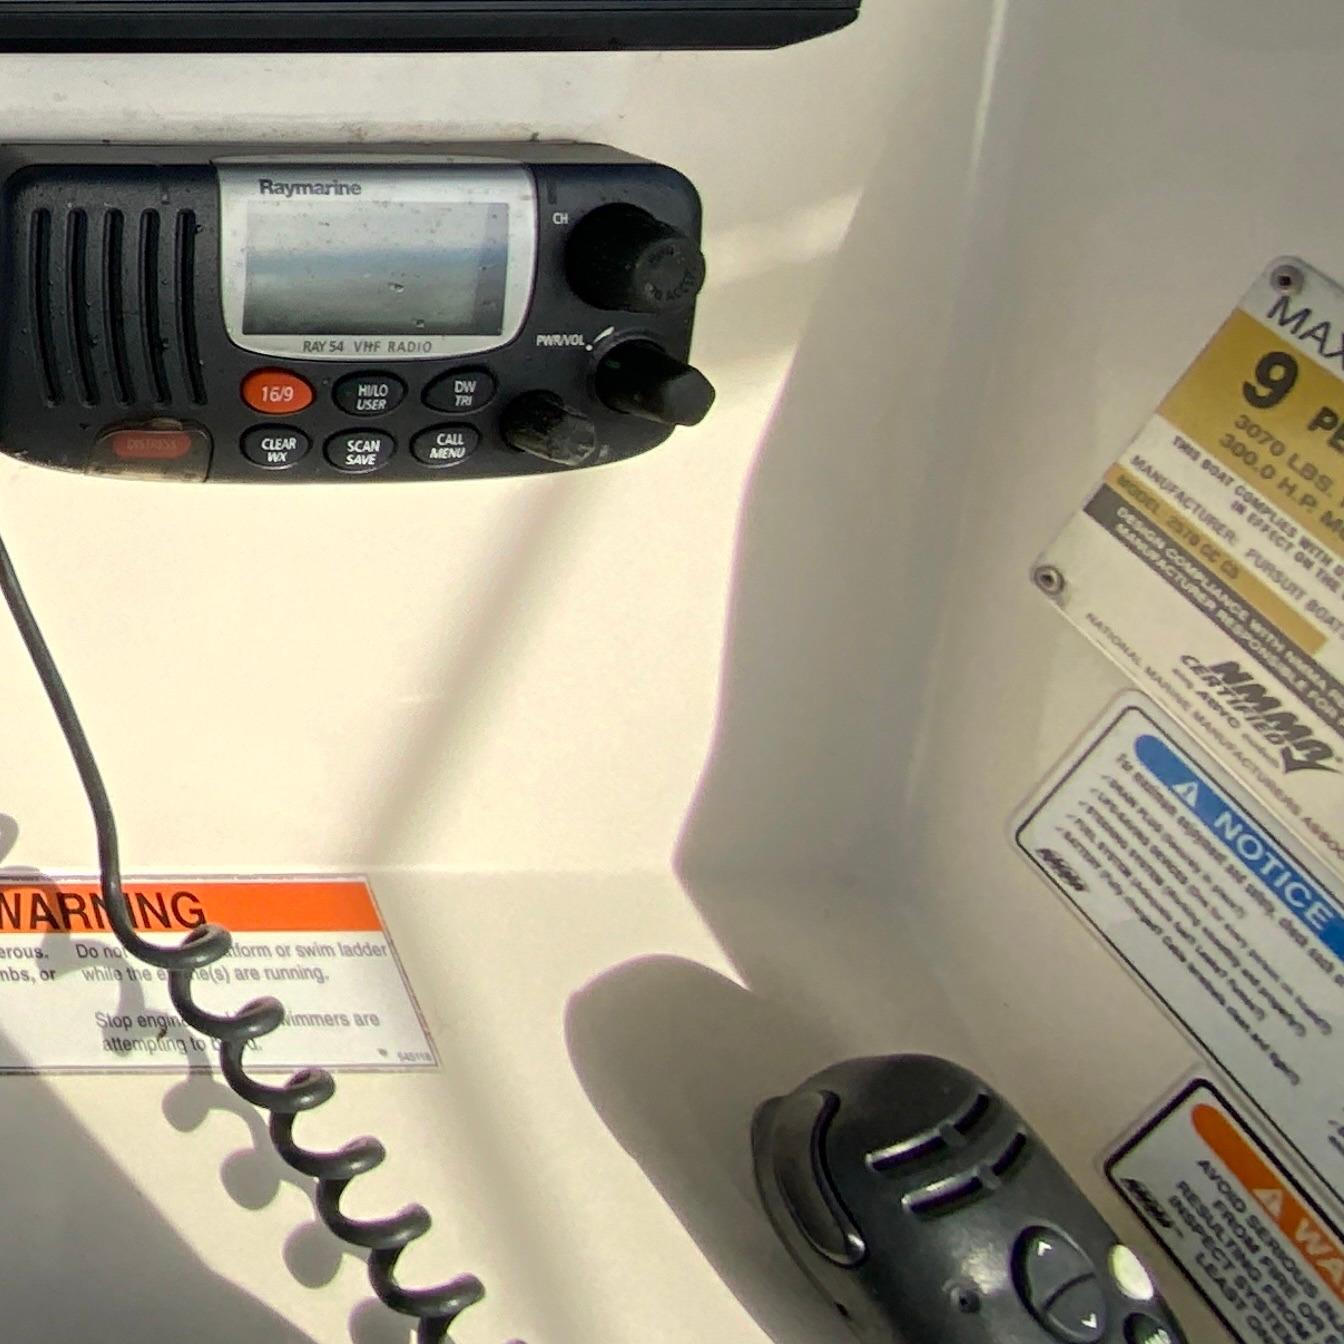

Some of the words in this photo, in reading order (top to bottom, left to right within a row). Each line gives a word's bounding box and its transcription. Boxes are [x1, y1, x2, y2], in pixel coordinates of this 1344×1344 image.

[259, 178, 362, 198] Raymarine
[552, 212, 569, 225] CH
[303, 340, 325, 353] RAY
[329, 340, 345, 353] 54
[354, 340, 381, 353] VHF
[388, 340, 433, 353] RADIO
[536, 334, 585, 347] PWR/VOL
[454, 379, 477, 394] DW
[1242, 351, 1299, 409] 9
[261, 385, 294, 403] 16/9
[455, 394, 473, 407] TRI
[356, 398, 387, 411] USER
[261, 437, 297, 451] CLEAR
[436, 432, 464, 446] CALL
[1234, 414, 1286, 457] 3070
[346, 439, 381, 453] SCAN
[429, 446, 467, 460] MENU
[267, 451, 287, 463] WX
[346, 453, 377, 466] SAVE
[1219, 432, 1277, 480] 300.0
[1199, 457, 1234, 488] BOAT
[1232, 483, 1299, 539] COMPLIES
[1244, 511, 1294, 554] EFFECT
[1162, 545, 1249, 621] COMPLIANCE
[1245, 548, 1307, 600] PURSUIT
[1177, 650, 1287, 749] CERTIFIED
[1214, 810, 1335, 931] NOTICE
[76, 943, 98, 959] Do
[276, 944, 291, 958] or
[296, 942, 336, 957] swim
[339, 941, 387, 957] ladder
[40, 969, 56, 982] or
[82, 967, 123, 982] while
[128, 966, 153, 982] the
[234, 967, 261, 982] are
[264, 964, 330, 984] running.
[95, 1011, 133, 1030] Stop
[354, 1013, 380, 1027] are
[102, 1038, 187, 1055] attempting
[192, 1038, 206, 1052] to
[1163, 1193, 1239, 1272] INSPECT
[1196, 1159, 1247, 1214] AVOID
[1245, 1213, 1319, 1300] SERIOUS
[1214, 1199, 1261, 1255] FROM
[1259, 1255, 1299, 1301] FIRE
[1170, 1179, 1269, 1283] RESULTING
[1262, 1283, 1311, 1341] FROM
[1195, 1252, 1247, 1311] LEAST
